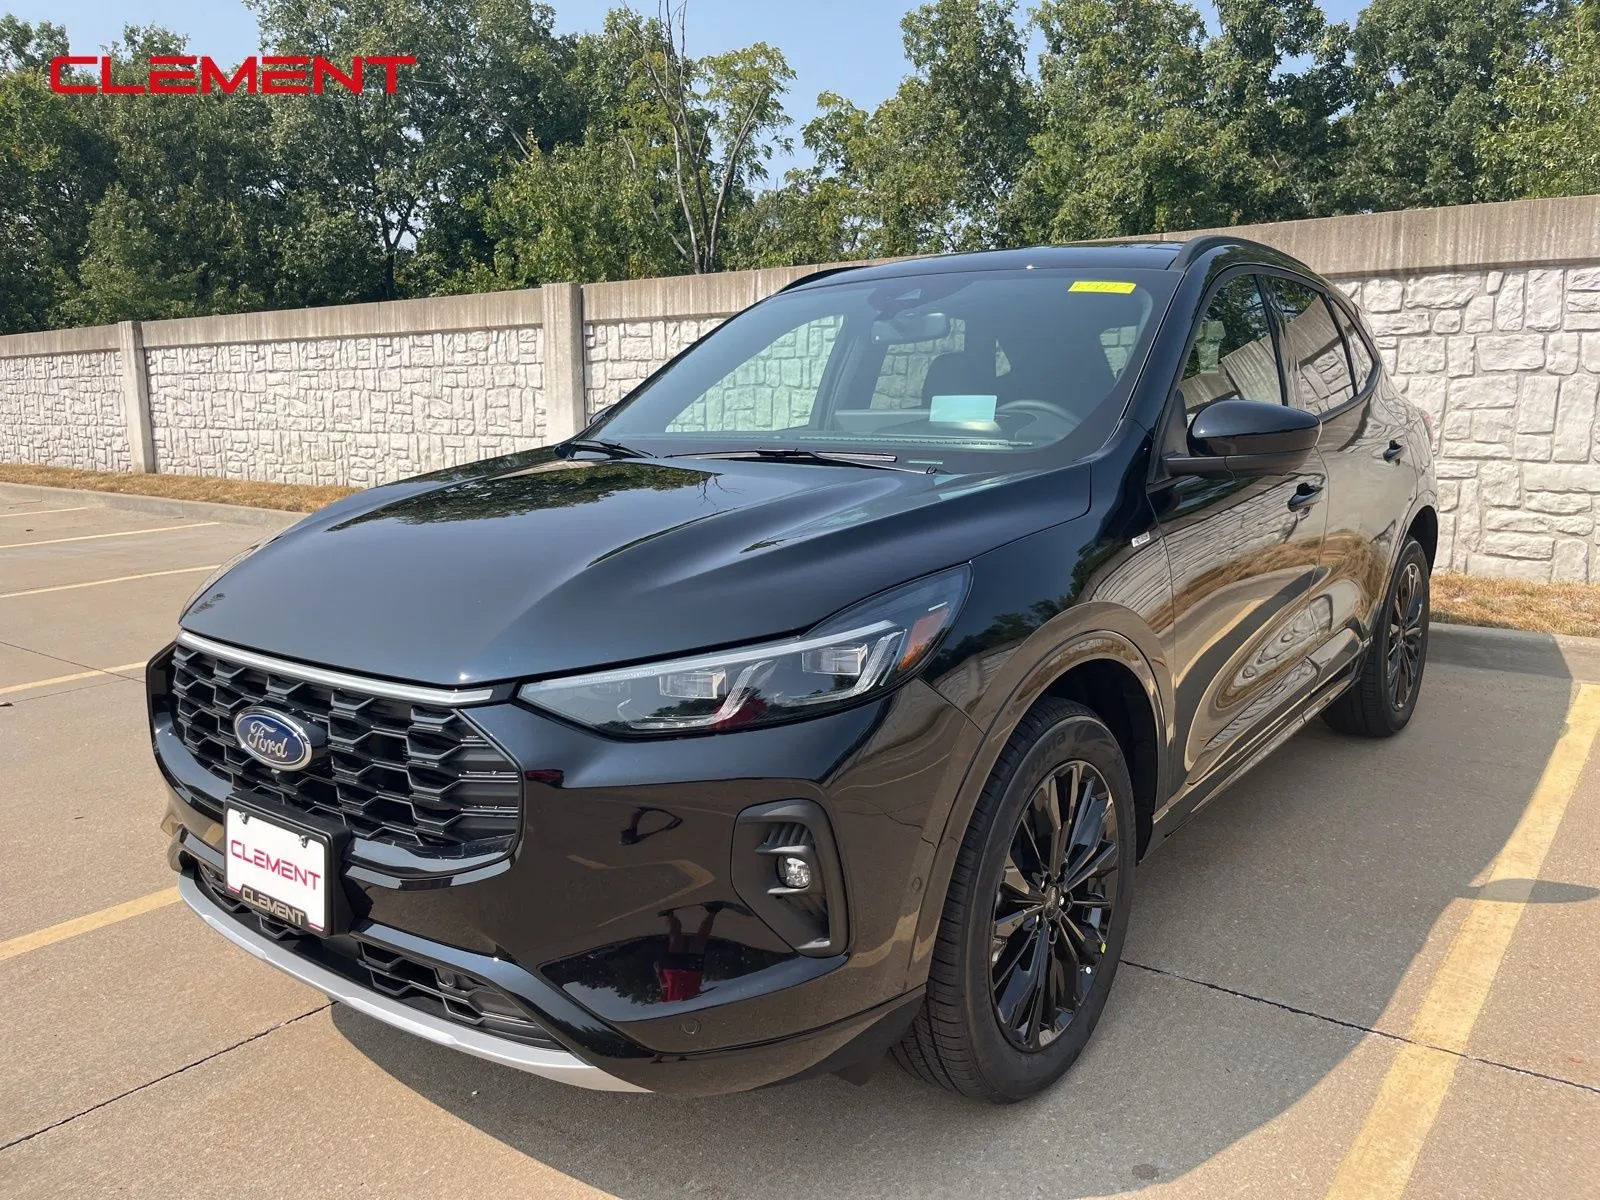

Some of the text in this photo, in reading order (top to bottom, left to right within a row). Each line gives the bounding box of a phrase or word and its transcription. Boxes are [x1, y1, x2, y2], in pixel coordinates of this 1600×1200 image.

[247, 720, 288, 758] Ford
[230, 839, 321, 891] CLEMENT
[242, 887, 305, 926] CLEMENT
